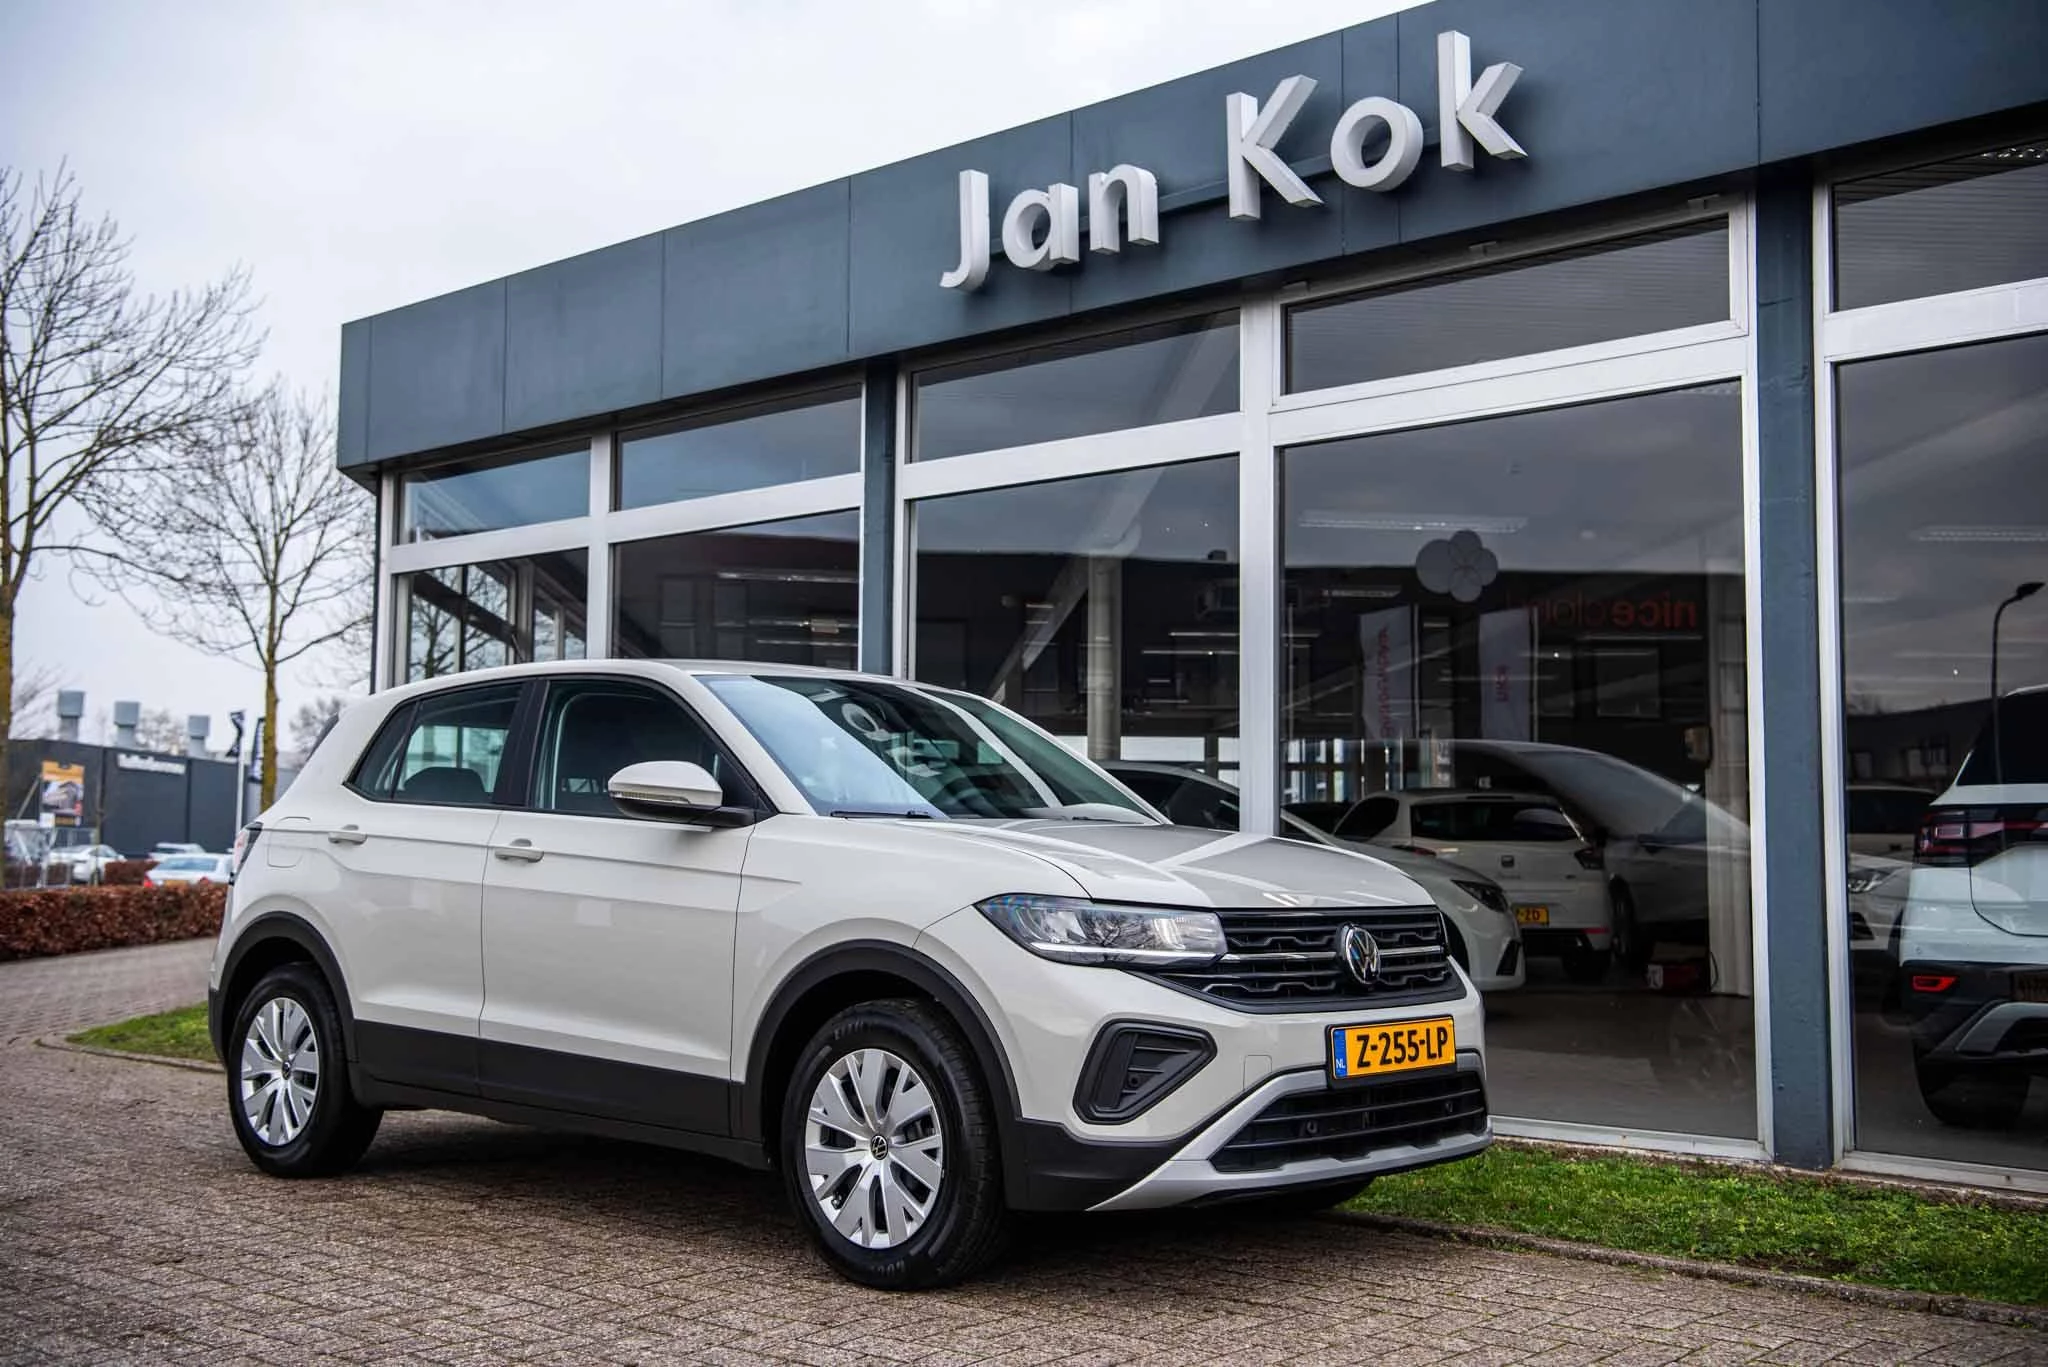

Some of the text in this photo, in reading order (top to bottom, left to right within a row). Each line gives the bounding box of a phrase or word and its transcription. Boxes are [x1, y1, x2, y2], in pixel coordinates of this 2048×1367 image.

[939, 30, 1529, 292] Jan Kok
[1335, 1026, 1448, 1069] NL Z-255-LP
